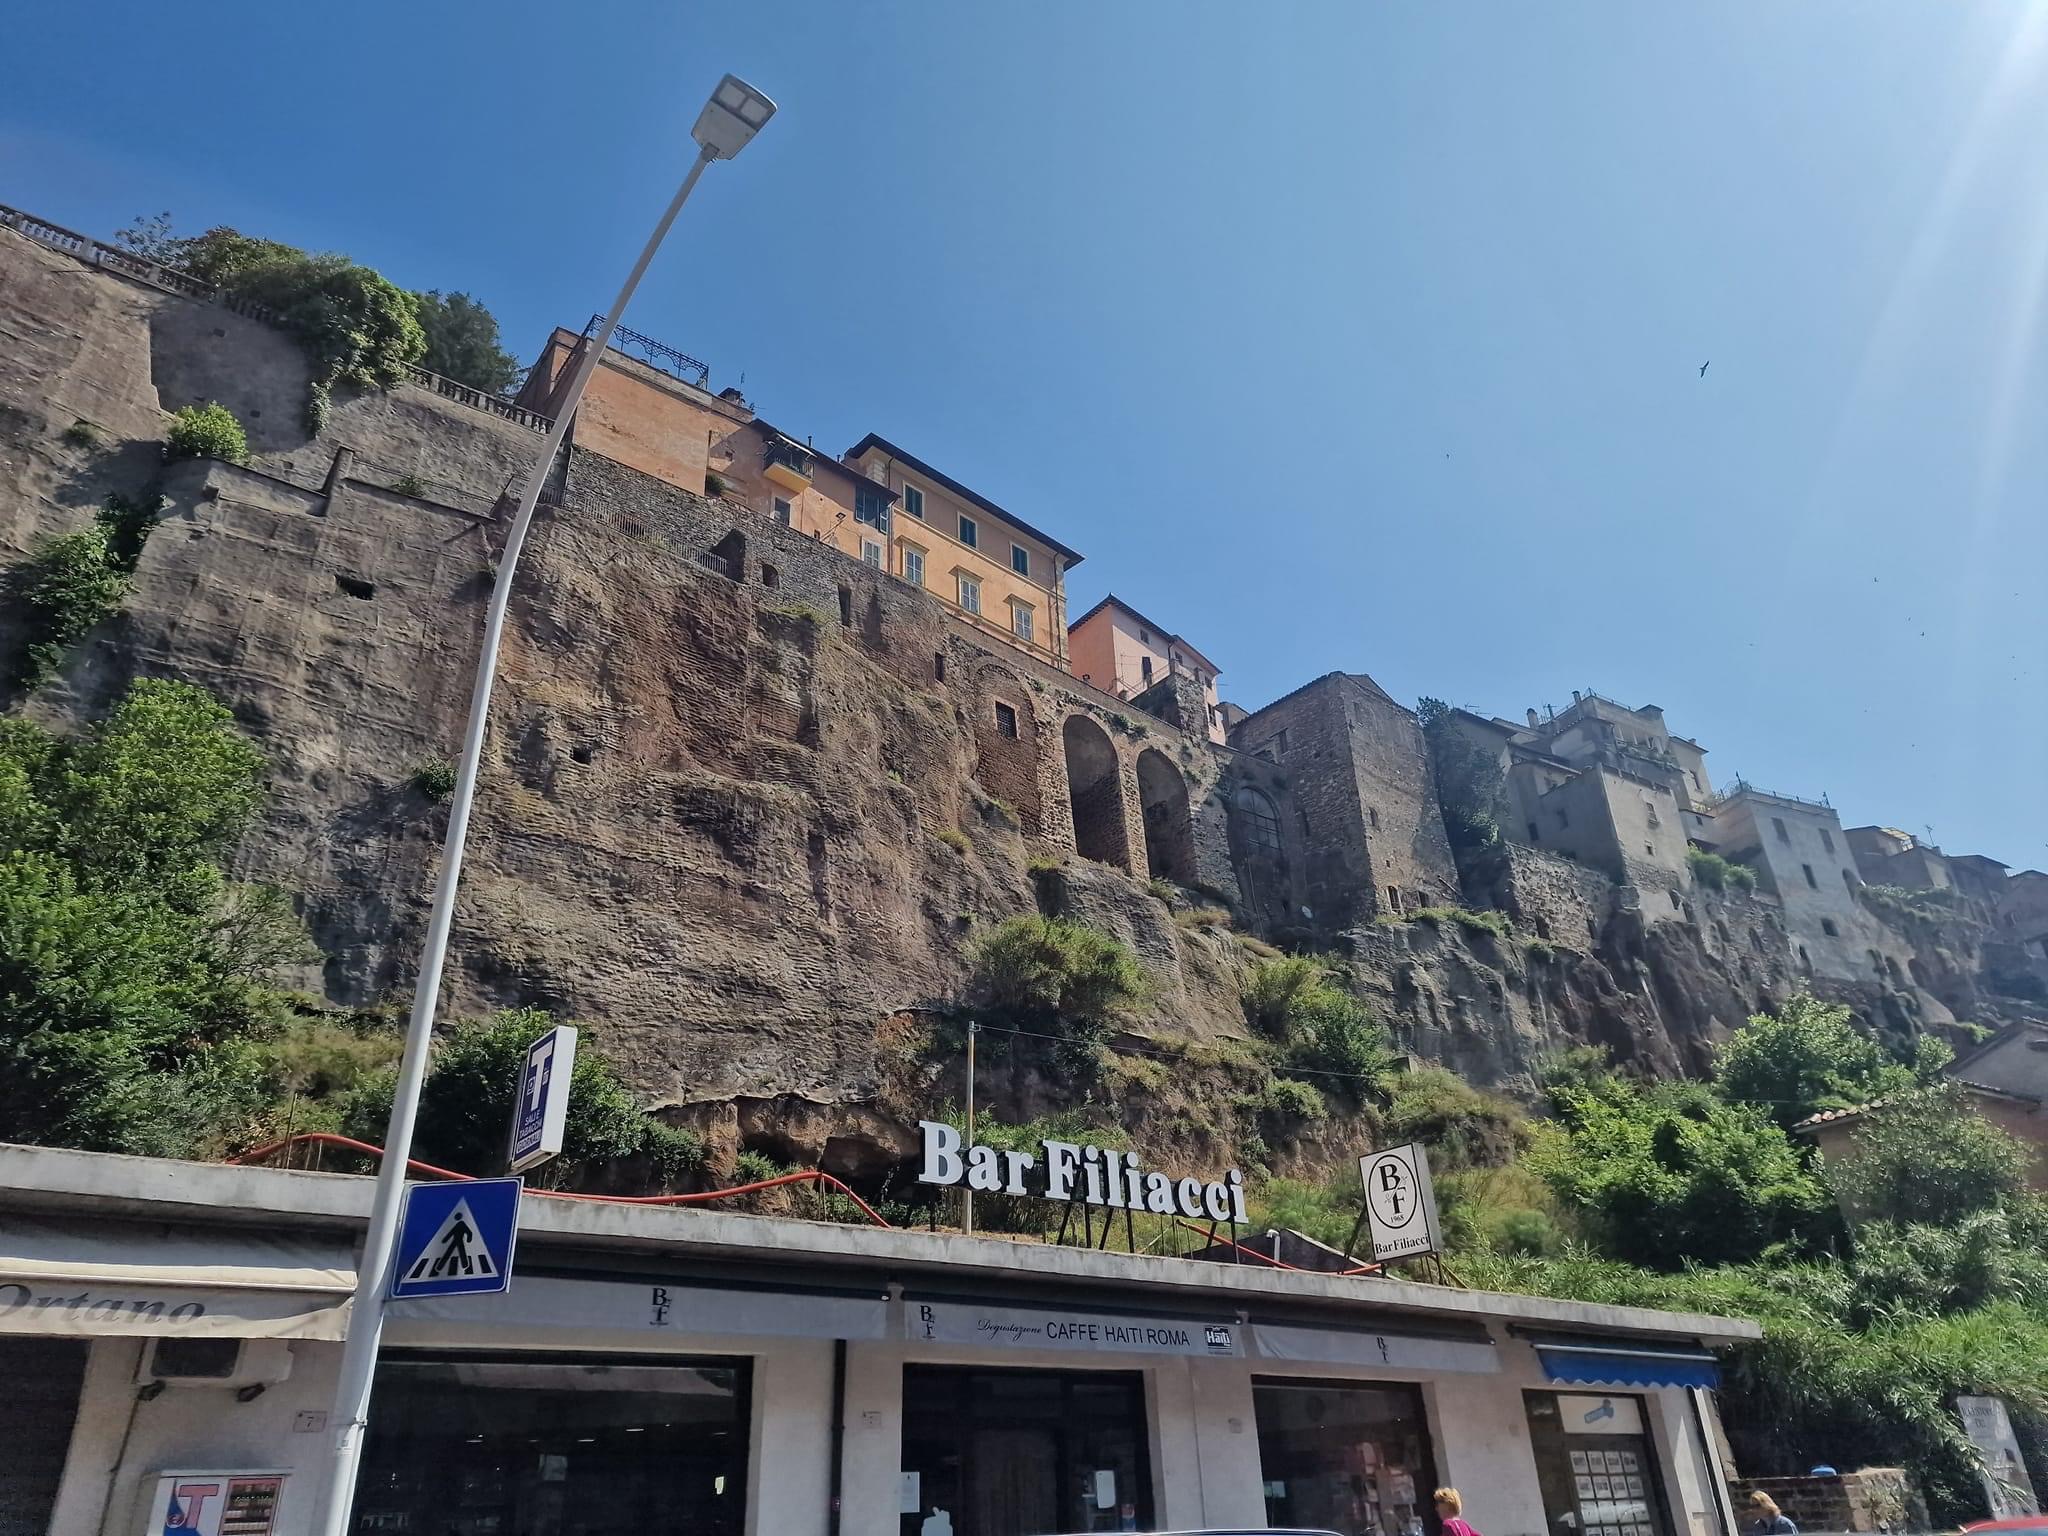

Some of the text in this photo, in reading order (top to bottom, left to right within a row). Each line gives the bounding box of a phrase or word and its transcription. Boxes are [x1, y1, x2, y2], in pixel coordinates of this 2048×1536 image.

[531, 1040, 553, 1111] T
[918, 1120, 1249, 1224] Bar Filiacci
[1375, 1233, 1430, 1254] Bar Filiacci
[977, 1318, 1191, 1346] Degustazione CAFFE' HAITI ROMA
